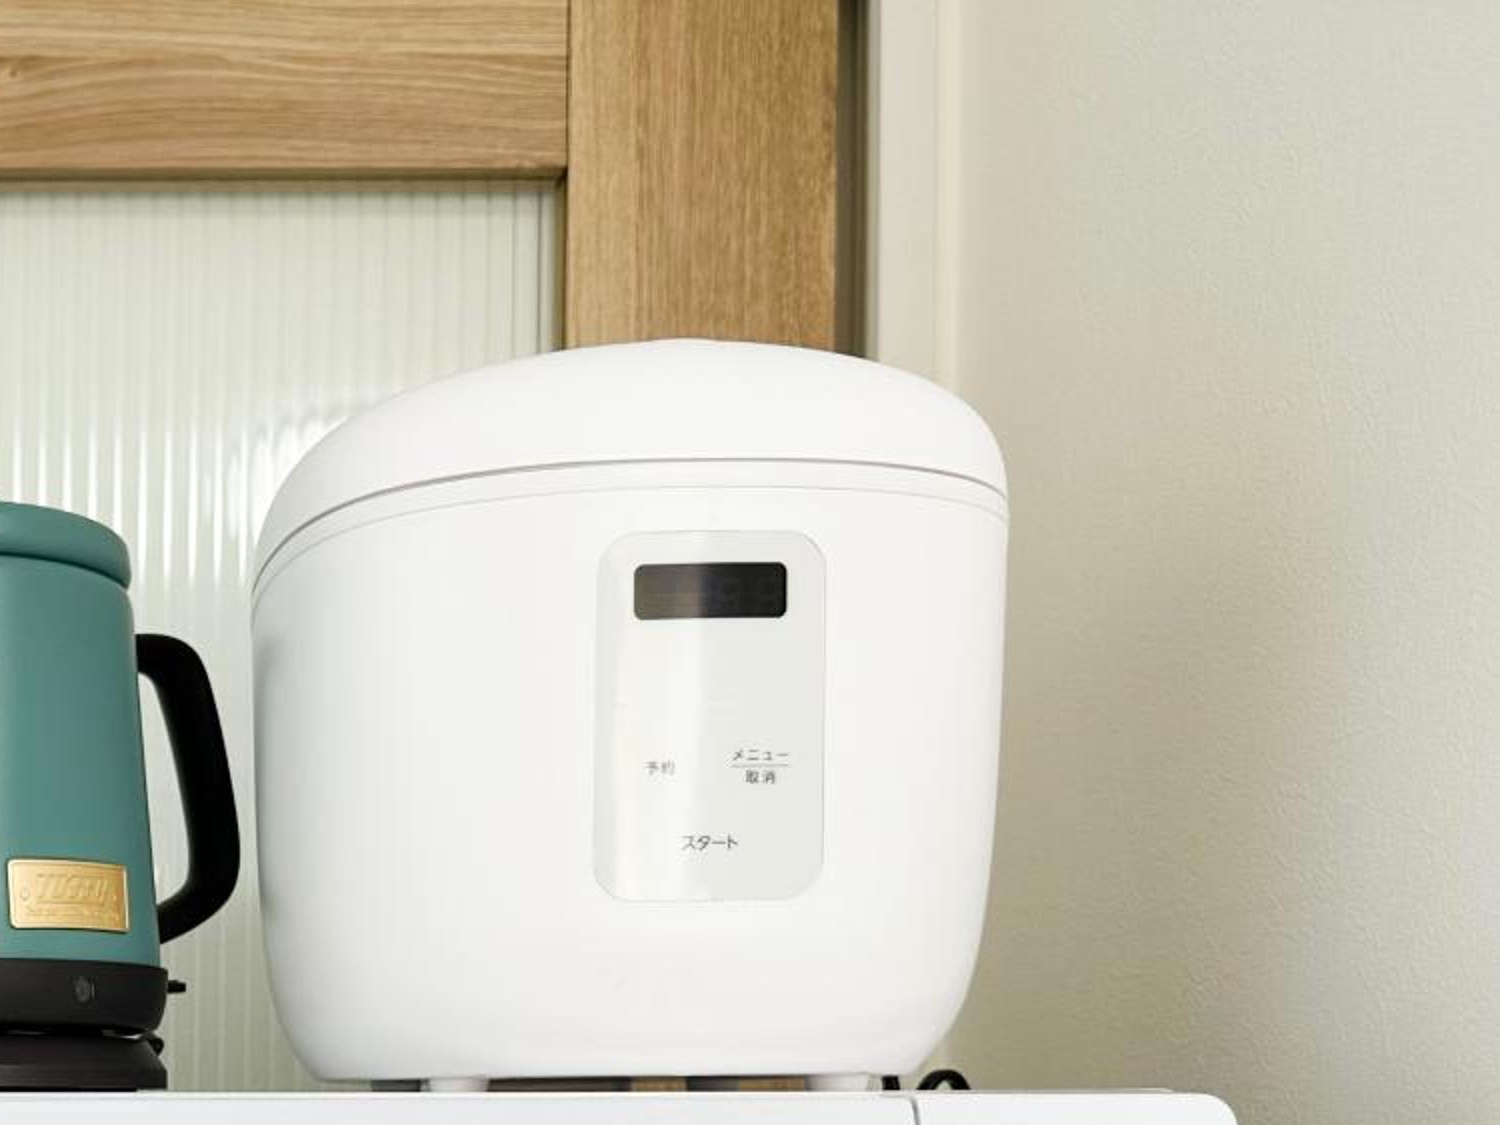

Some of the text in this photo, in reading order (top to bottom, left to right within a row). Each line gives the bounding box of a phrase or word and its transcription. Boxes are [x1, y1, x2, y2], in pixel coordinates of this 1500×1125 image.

[731, 748, 789, 761] メニュー
[682, 834, 739, 851] スタート
